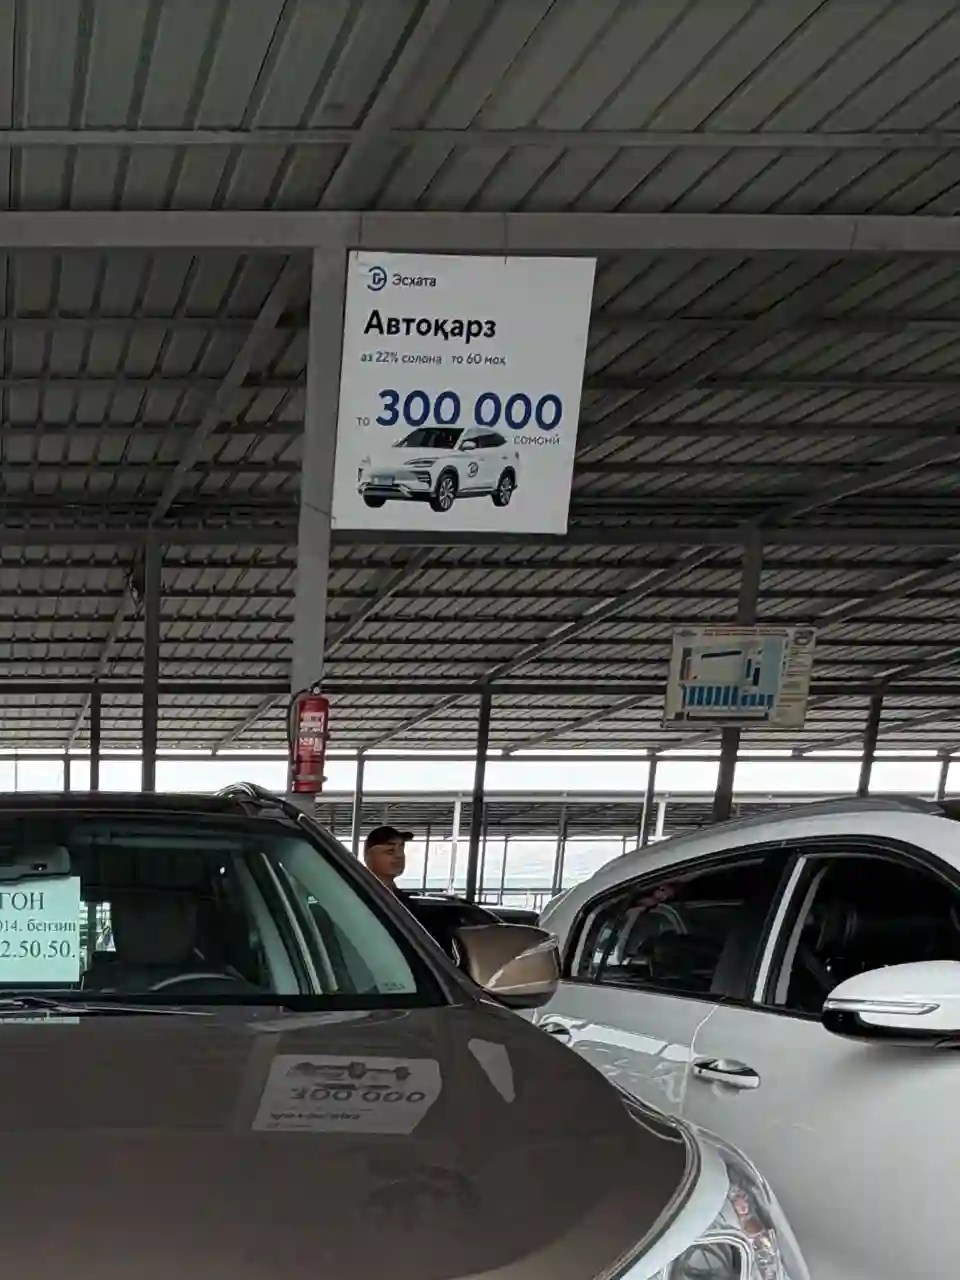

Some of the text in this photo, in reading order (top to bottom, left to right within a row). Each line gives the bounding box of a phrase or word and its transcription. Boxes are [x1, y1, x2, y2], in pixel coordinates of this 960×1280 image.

[392, 273, 437, 287] Эсхата
[363, 309, 497, 344] Автоқарз
[452, 355, 464, 364] то
[466, 353, 482, 365] 60
[356, 388, 563, 431] то 300 000
[27, 916, 77, 932] бензин
